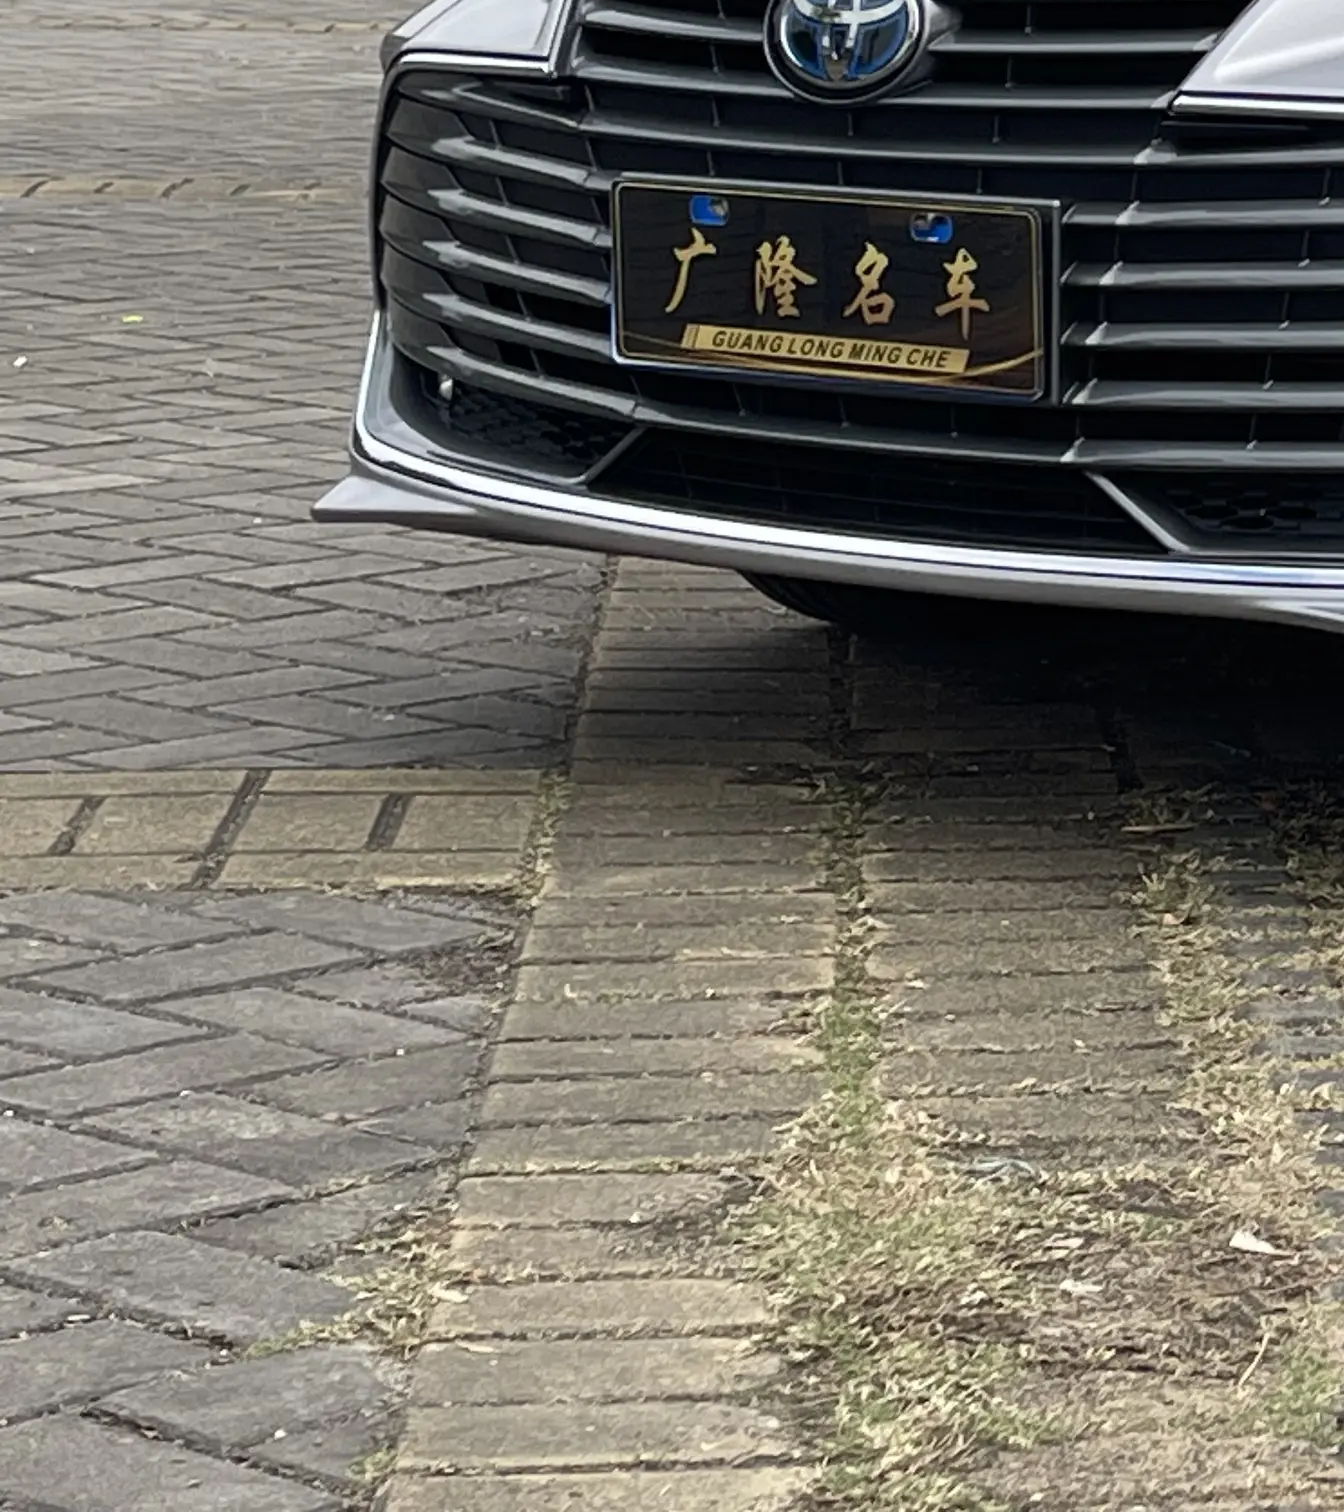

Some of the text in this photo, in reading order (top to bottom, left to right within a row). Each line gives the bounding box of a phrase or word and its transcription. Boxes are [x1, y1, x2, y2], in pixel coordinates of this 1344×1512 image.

[665, 228, 989, 340] 广隆名车
[712, 330, 952, 368] GUANG LONG MING CHE
